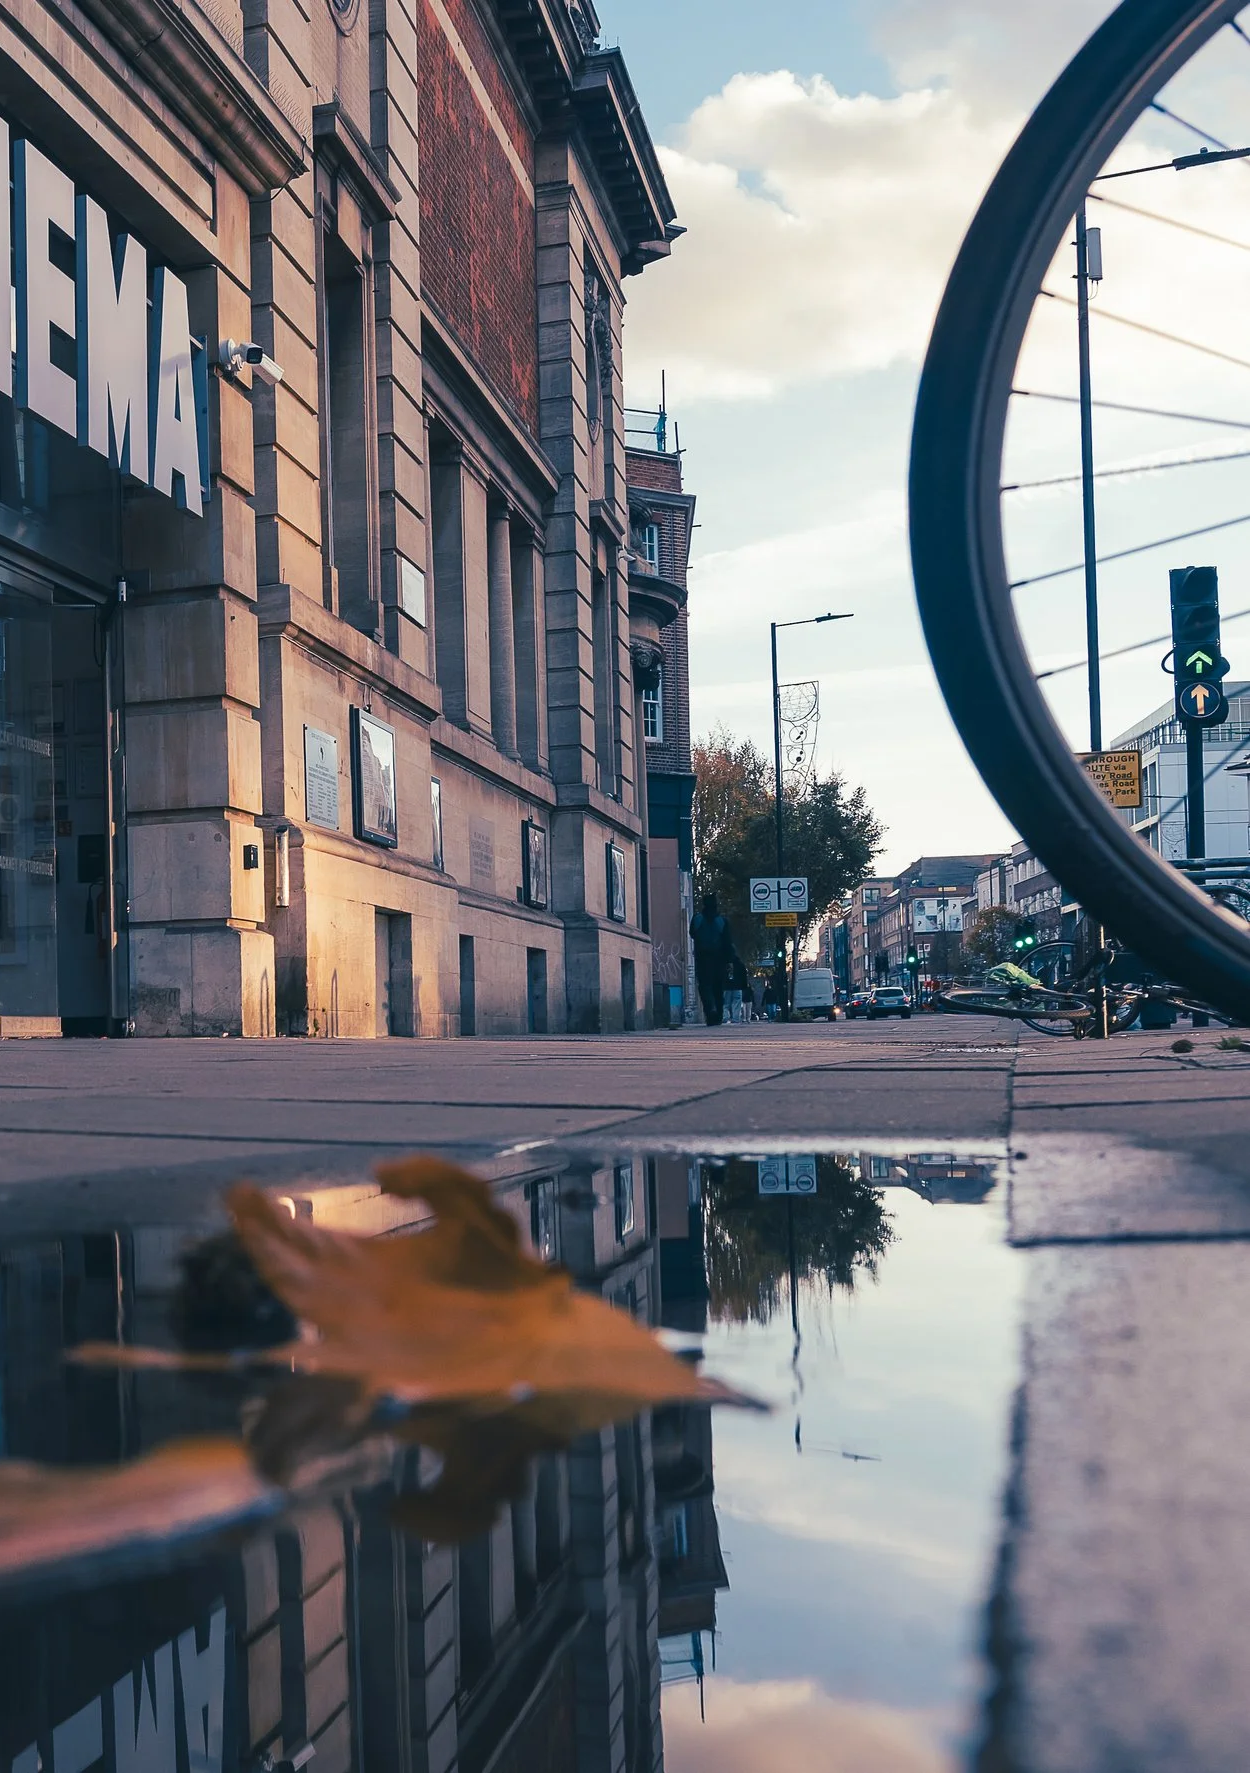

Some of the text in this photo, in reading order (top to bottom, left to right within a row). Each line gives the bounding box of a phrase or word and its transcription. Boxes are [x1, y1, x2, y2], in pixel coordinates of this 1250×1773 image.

[1087, 755, 1135, 763] HROUGH
[1085, 764, 1110, 772] OUTE
[1092, 773, 1106, 781] ley
[19, 859, 54, 876] PICTUREHOUSE
